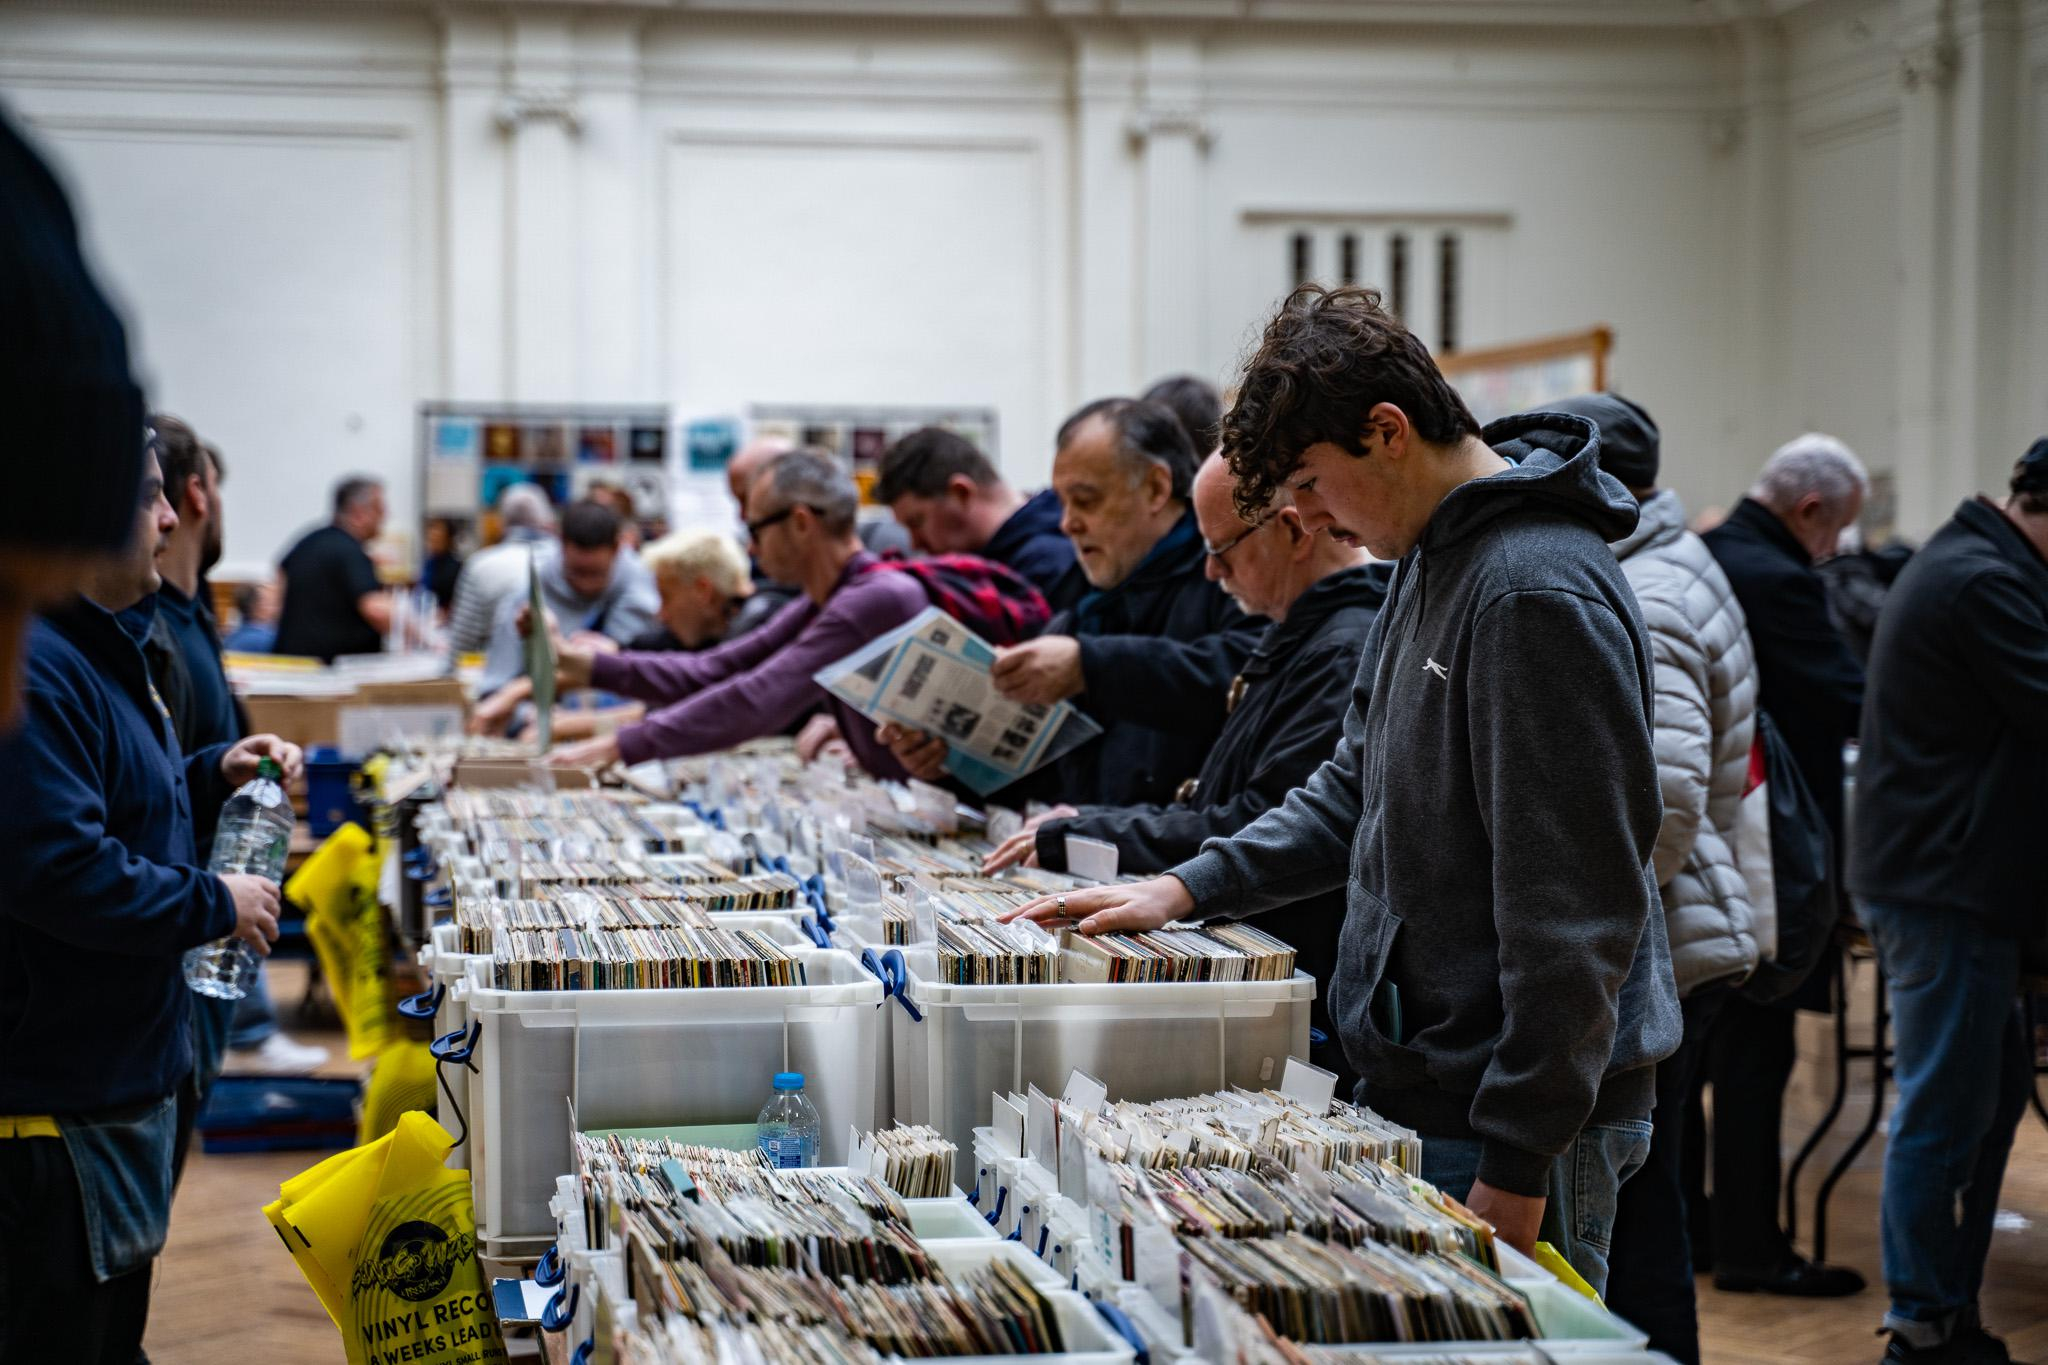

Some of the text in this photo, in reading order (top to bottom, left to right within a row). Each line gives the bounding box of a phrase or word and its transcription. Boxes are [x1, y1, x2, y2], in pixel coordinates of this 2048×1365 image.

[362, 1292, 490, 1344] VINYL RECO
[383, 1335, 447, 1365] WEEKS
[451, 1322, 491, 1347] LEAD
[456, 1351, 481, 1364] SMALL
